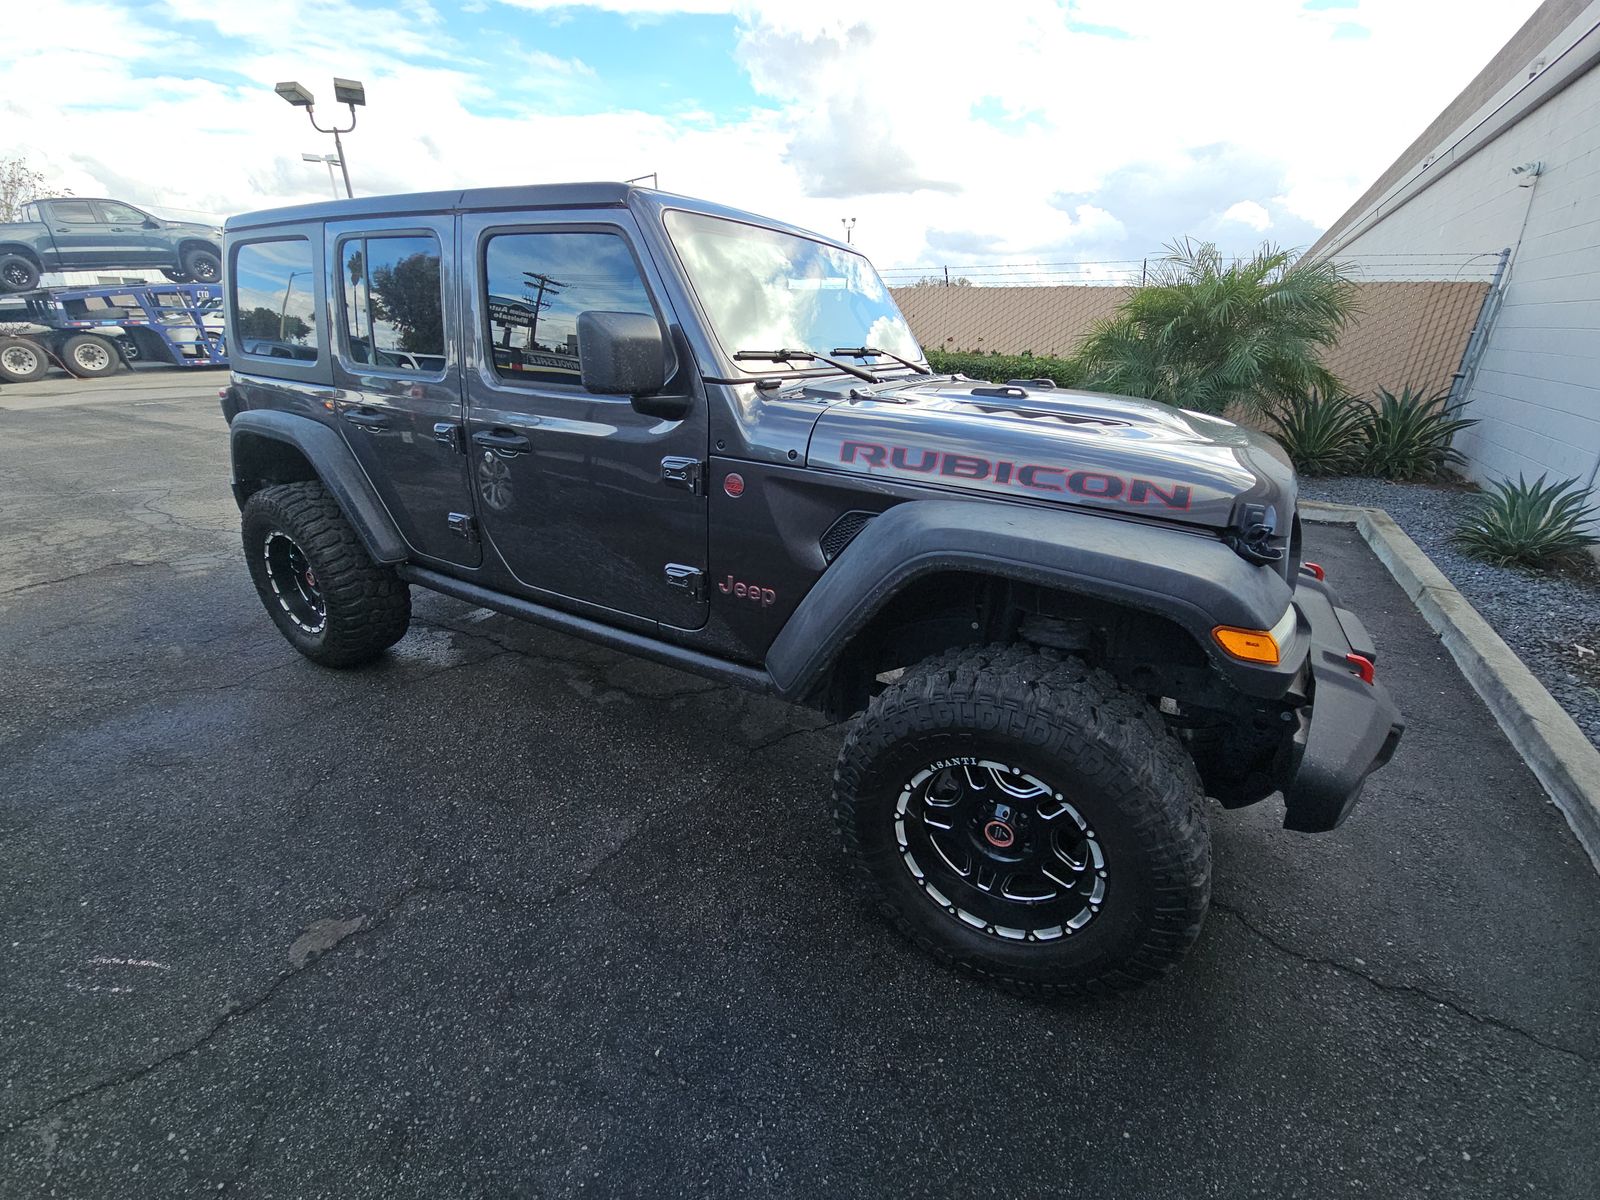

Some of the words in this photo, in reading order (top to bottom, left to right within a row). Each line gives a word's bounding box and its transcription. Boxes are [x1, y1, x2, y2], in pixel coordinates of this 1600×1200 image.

[840, 441, 1193, 511] RUBICON
[718, 575, 776, 607] Jeep
[930, 757, 977, 771] ASANTI
